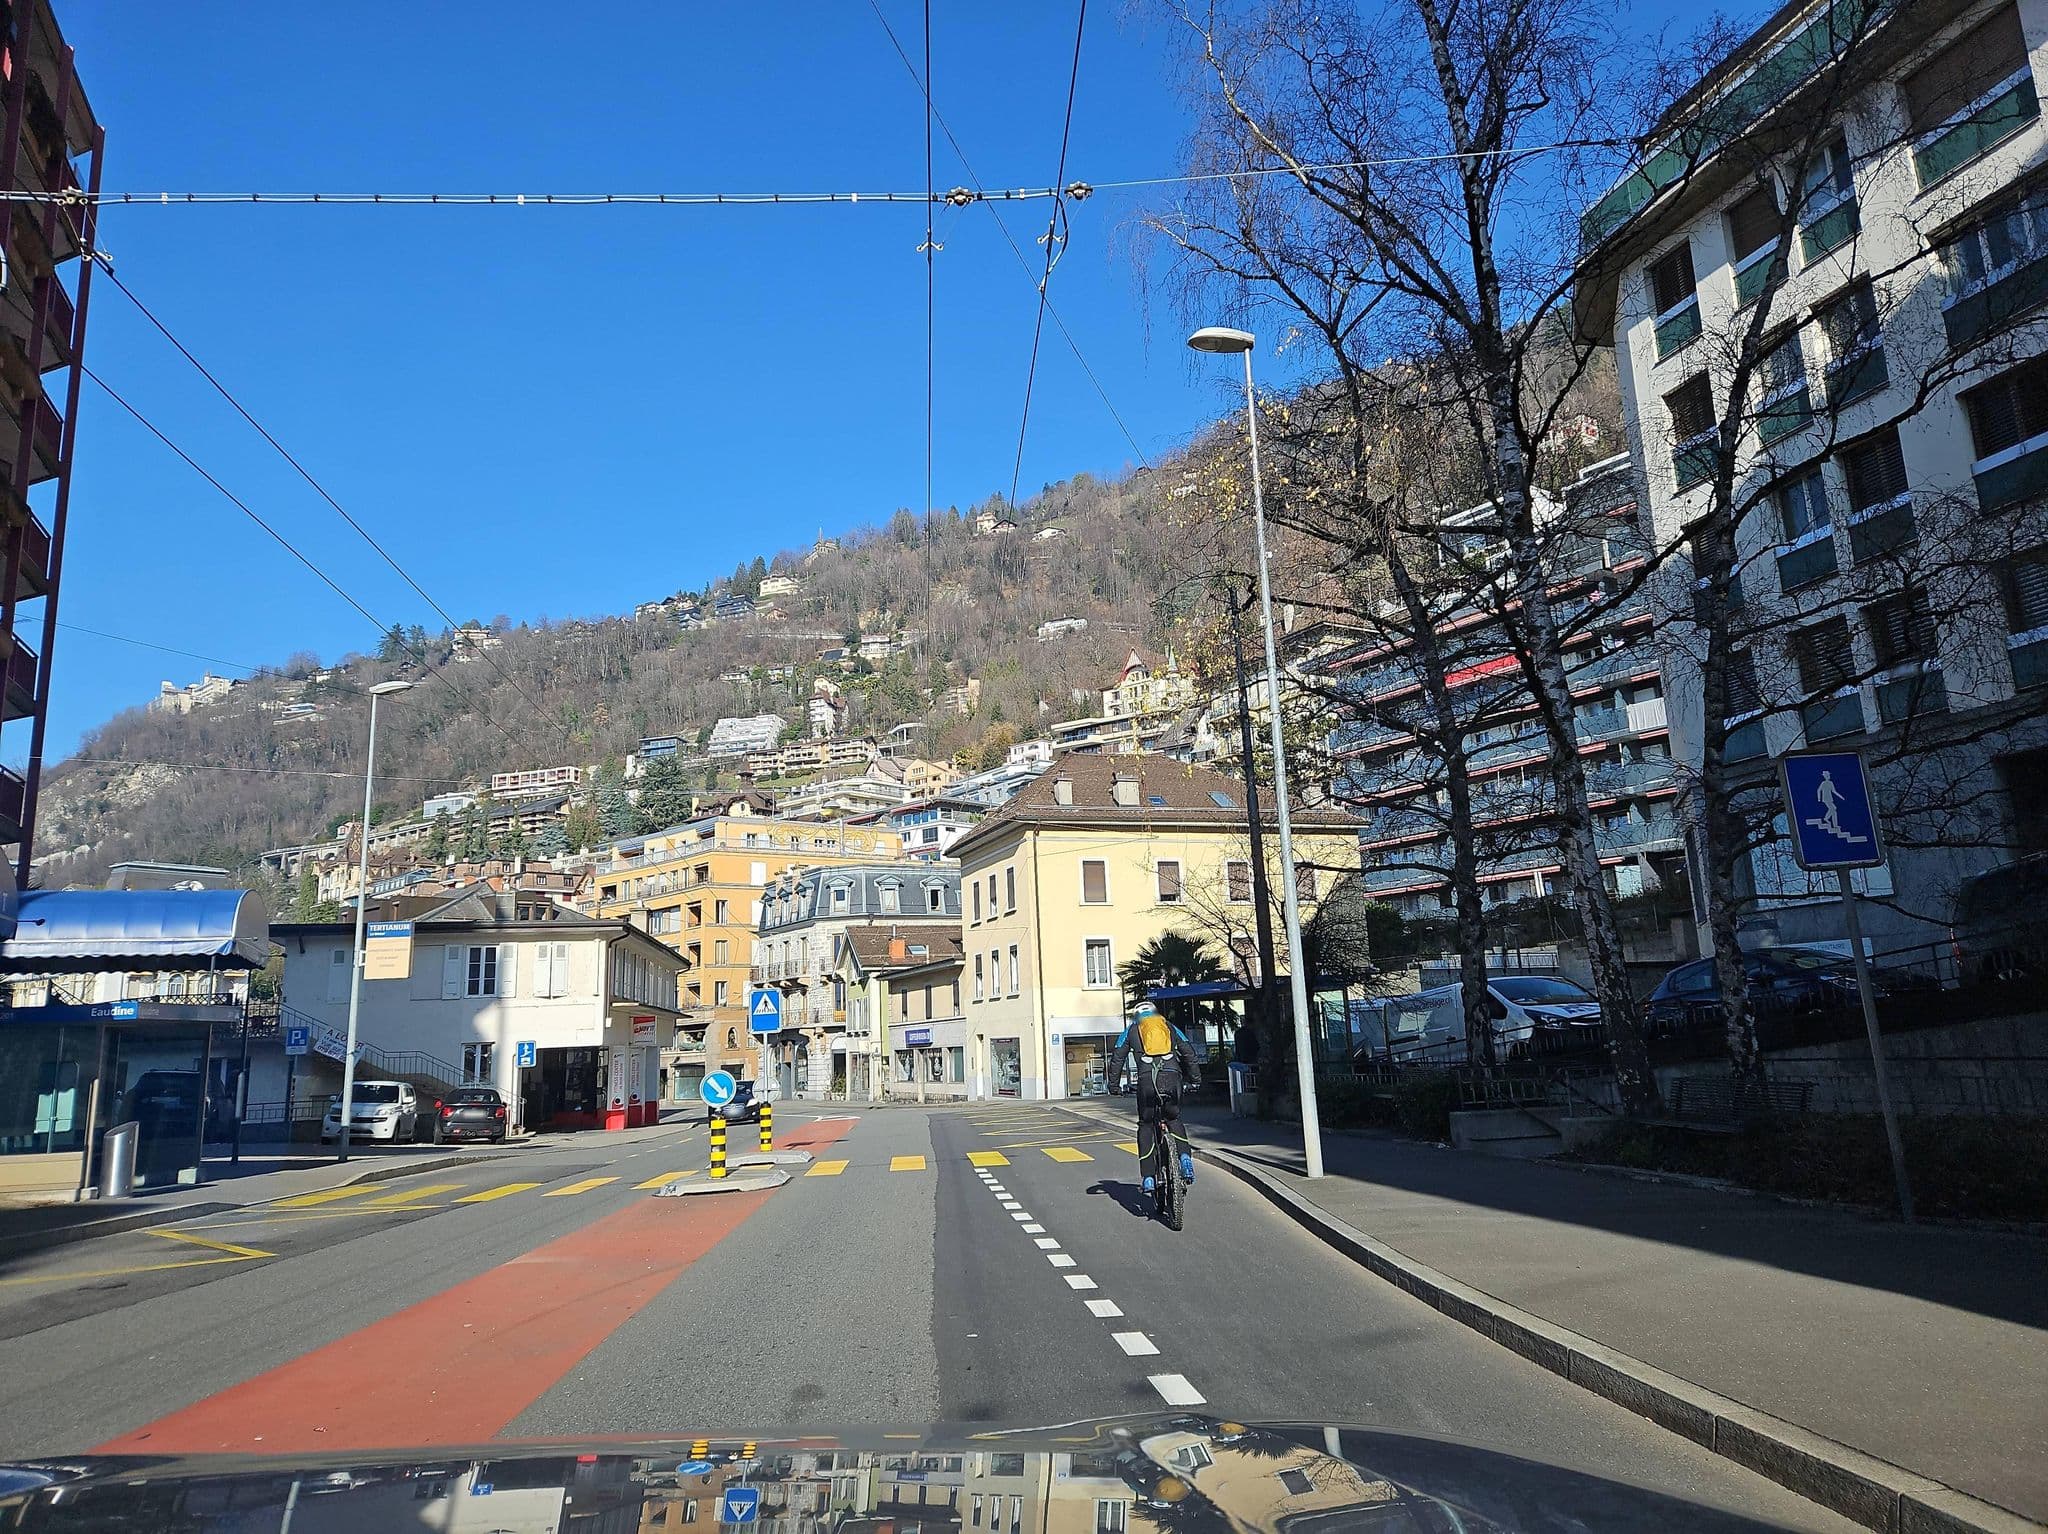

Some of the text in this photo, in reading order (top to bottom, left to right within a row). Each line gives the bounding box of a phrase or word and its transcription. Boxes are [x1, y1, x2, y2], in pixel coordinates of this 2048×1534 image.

[370, 924, 410, 932] TERTIANUM
[91, 1004, 134, 1017] Eaudine
[292, 1030, 302, 1044] P
[326, 1028, 334, 1038] A
[335, 1031, 364, 1050] LOER
